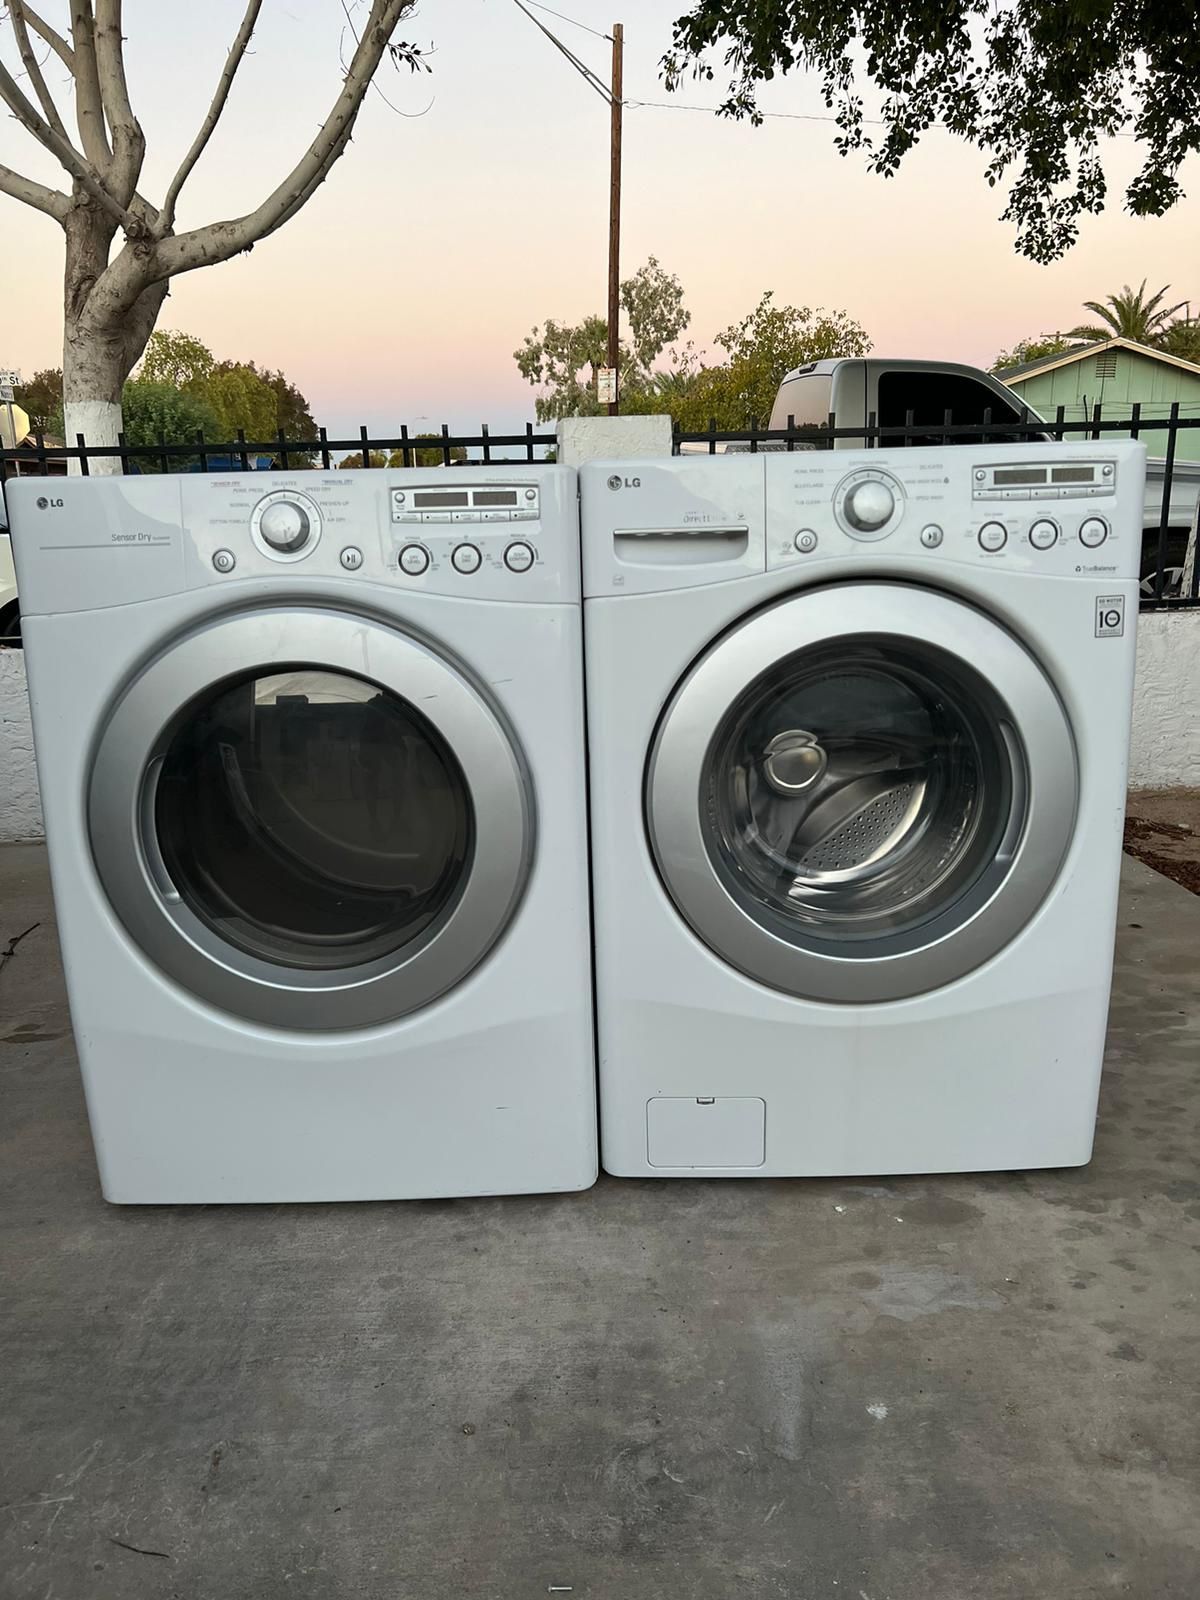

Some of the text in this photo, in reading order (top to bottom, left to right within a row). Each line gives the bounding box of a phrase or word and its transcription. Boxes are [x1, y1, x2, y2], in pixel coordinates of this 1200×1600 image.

[9, 376, 19, 385] St
[624, 477, 641, 488] LG
[50, 498, 64, 508] LG
[111, 533, 137, 542] Sensor
[138, 533, 152, 542] Dry
[1099, 609, 1121, 628] 10
